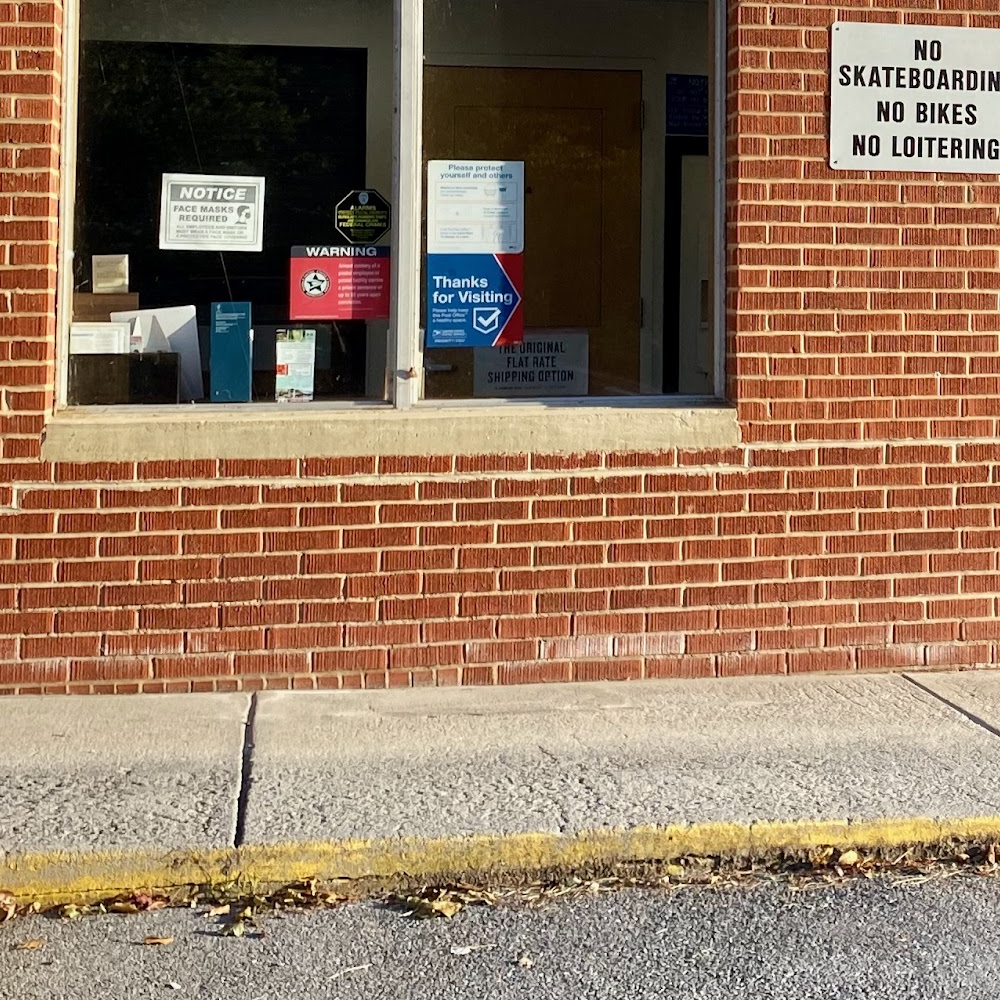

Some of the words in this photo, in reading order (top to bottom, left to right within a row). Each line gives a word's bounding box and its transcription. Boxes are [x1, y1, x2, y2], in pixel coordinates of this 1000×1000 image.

[914, 39, 942, 61] NO
[877, 101, 905, 123] NO
[916, 102, 977, 125] BIKES
[852, 134, 880, 156] NO
[892, 136, 1000, 160] LOITERING
[179, 187, 247, 201] NOTICE
[306, 247, 377, 256] WARNING
[432, 275, 488, 288] Thanks
[433, 291, 454, 304] for
[458, 291, 513, 305] Visiting
[499, 344, 516, 354] THE
[519, 341, 565, 354] ORIGINAL
[507, 356, 528, 368] FLAT
[532, 356, 557, 368] RATE
[487, 371, 535, 384] SHIPPING
[538, 370, 574, 382] OPTION
